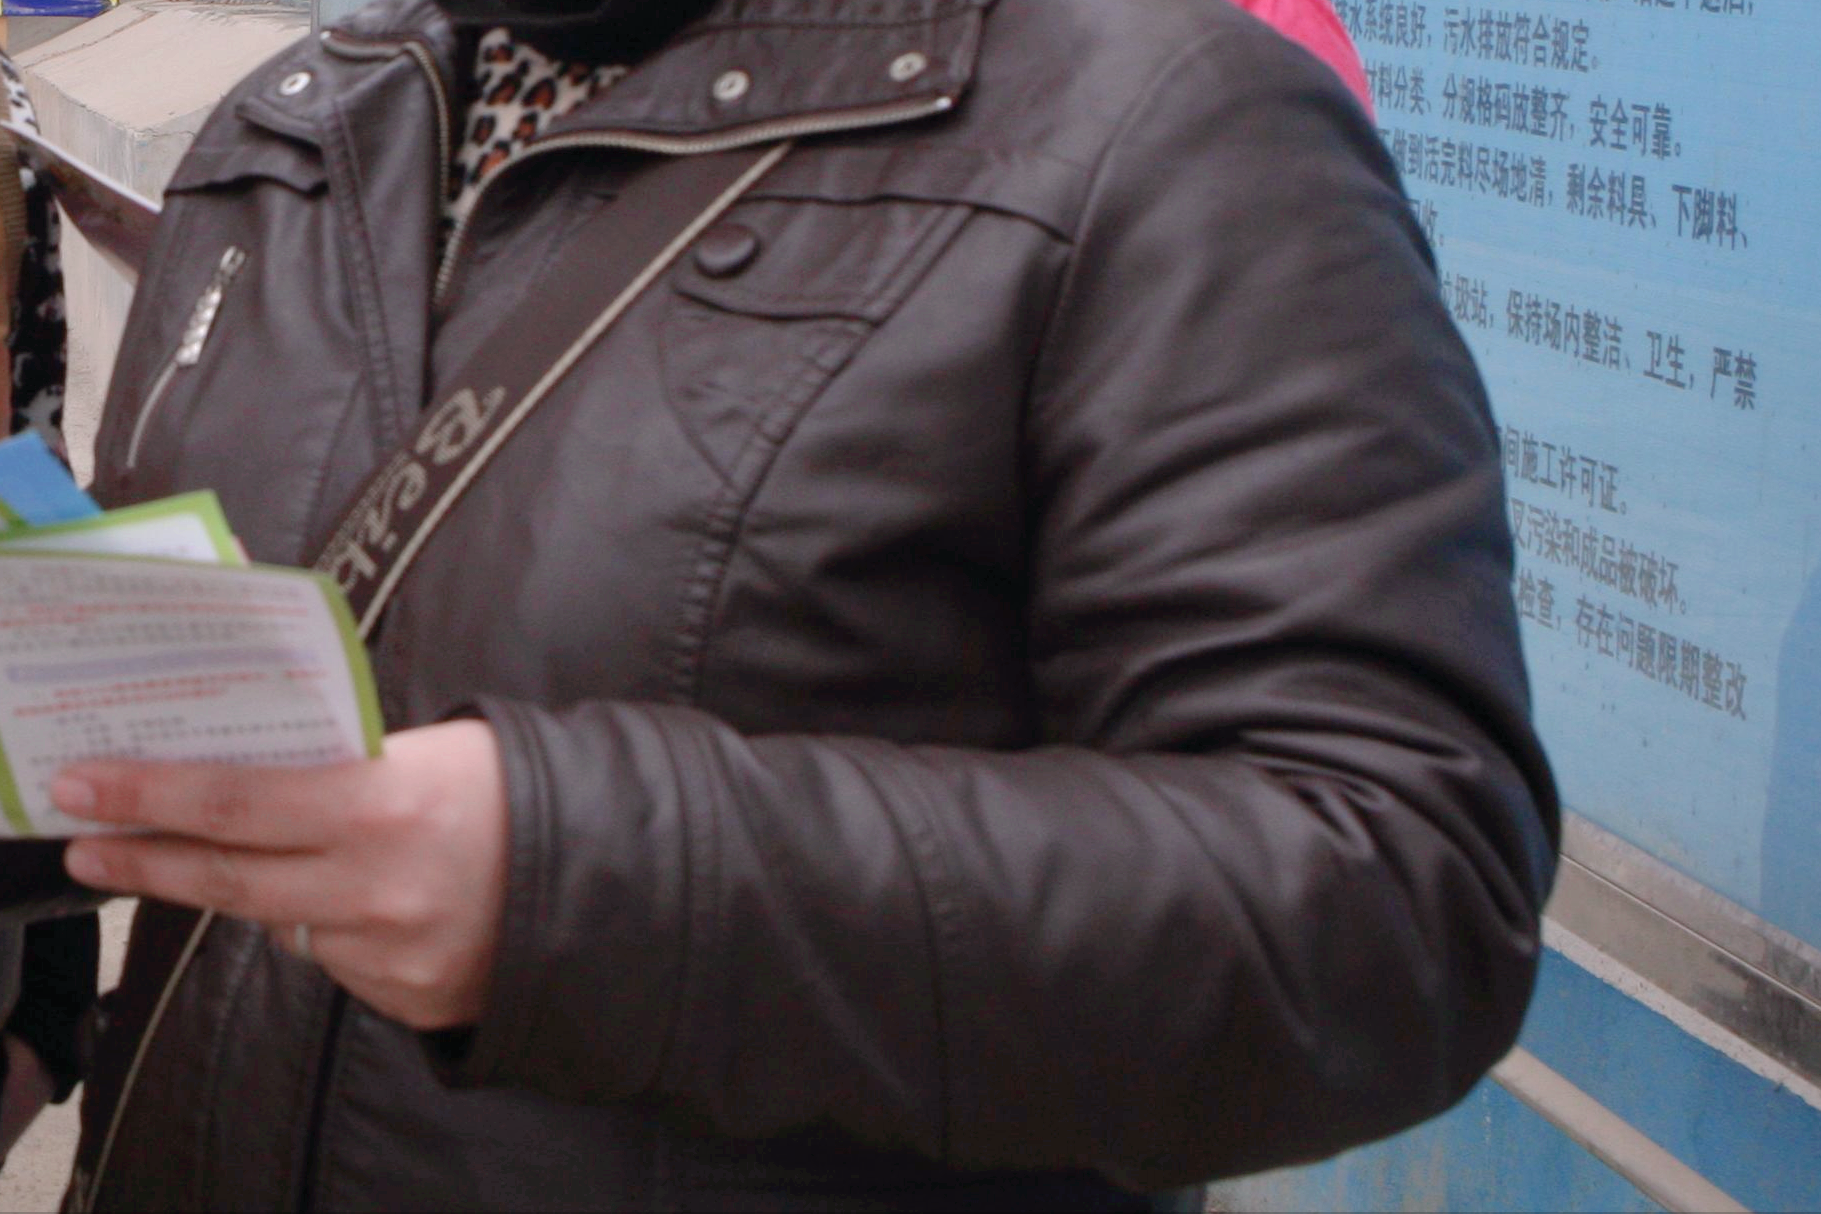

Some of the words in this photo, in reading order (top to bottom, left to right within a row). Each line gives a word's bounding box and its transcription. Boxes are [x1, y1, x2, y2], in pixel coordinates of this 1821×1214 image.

[1378, 128, 1749, 251] 做到活完料尽场地清，剩余料具、下脚料、
[1499, 424, 1628, 516] 间施工许可证。
